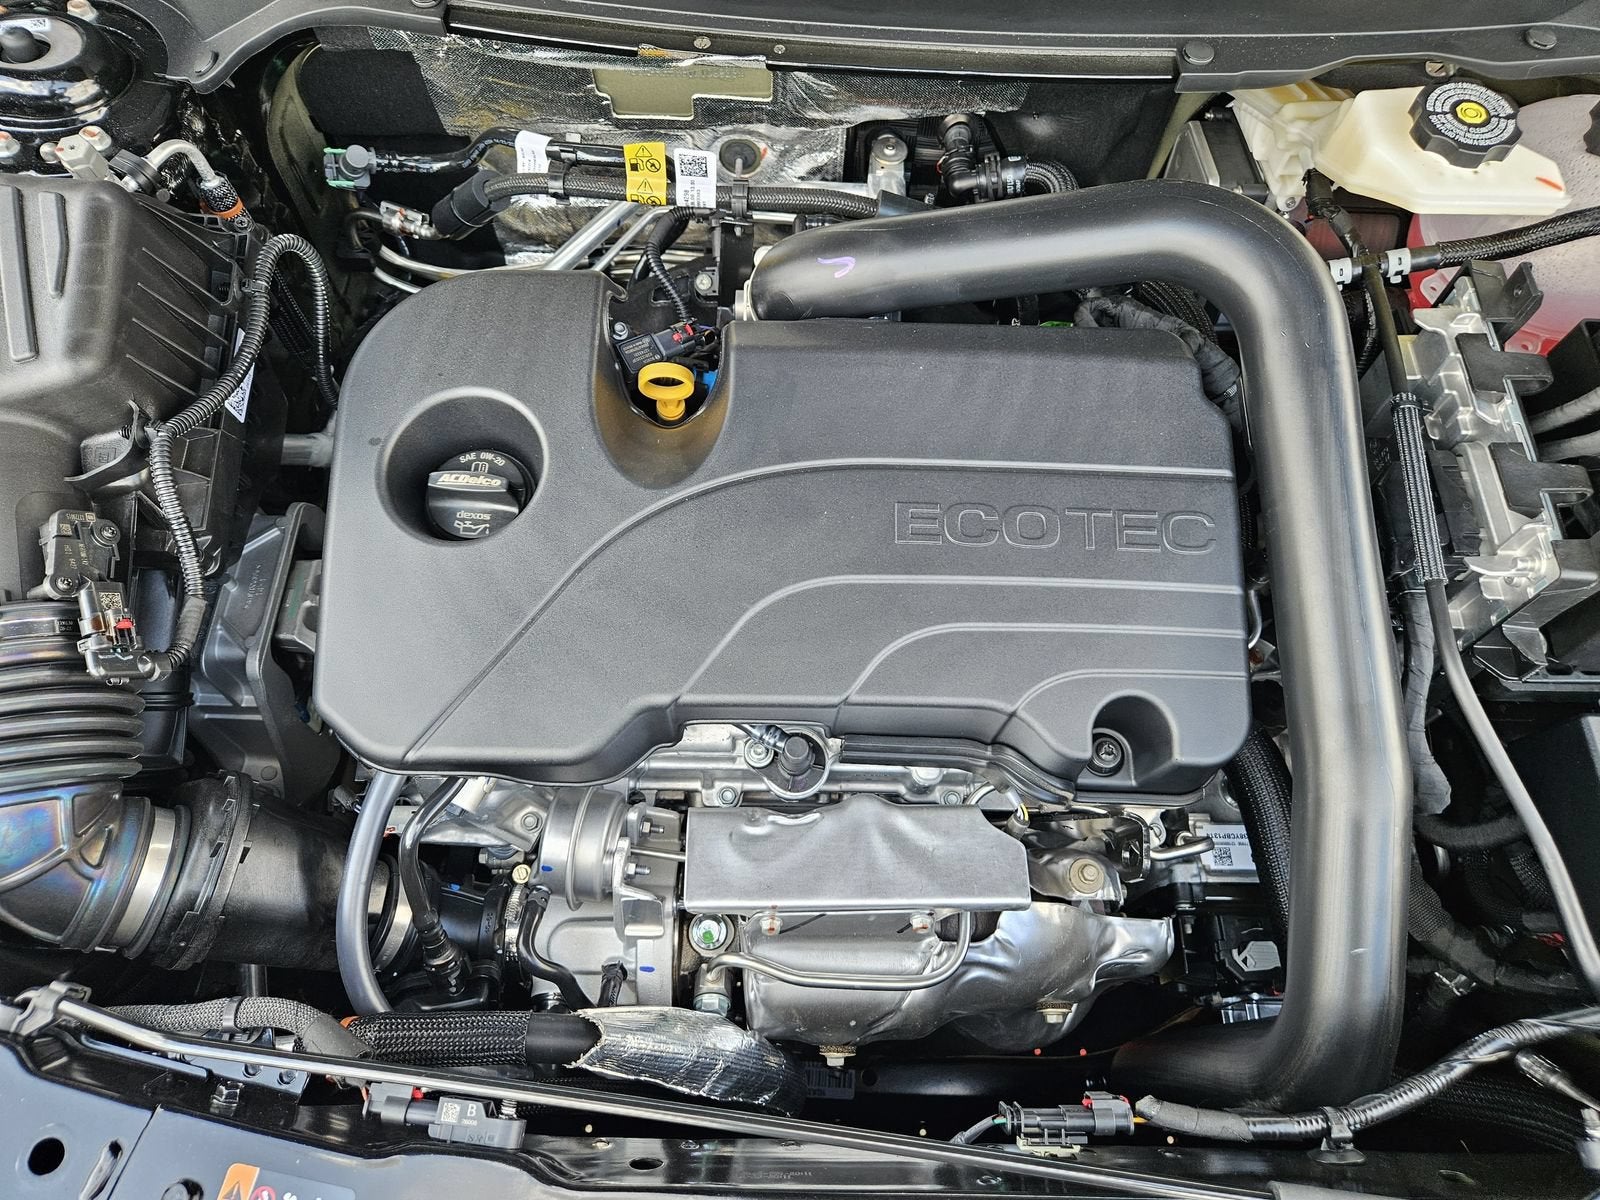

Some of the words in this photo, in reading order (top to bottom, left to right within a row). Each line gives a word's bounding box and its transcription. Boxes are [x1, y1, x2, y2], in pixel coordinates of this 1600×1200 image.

[459, 452, 477, 463] SAE
[480, 451, 506, 466] 0W-20
[437, 473, 502, 486] ACDelco
[456, 510, 492, 521] dexos
[894, 502, 1217, 555] ECOTEC
[467, 1103, 477, 1117] B
